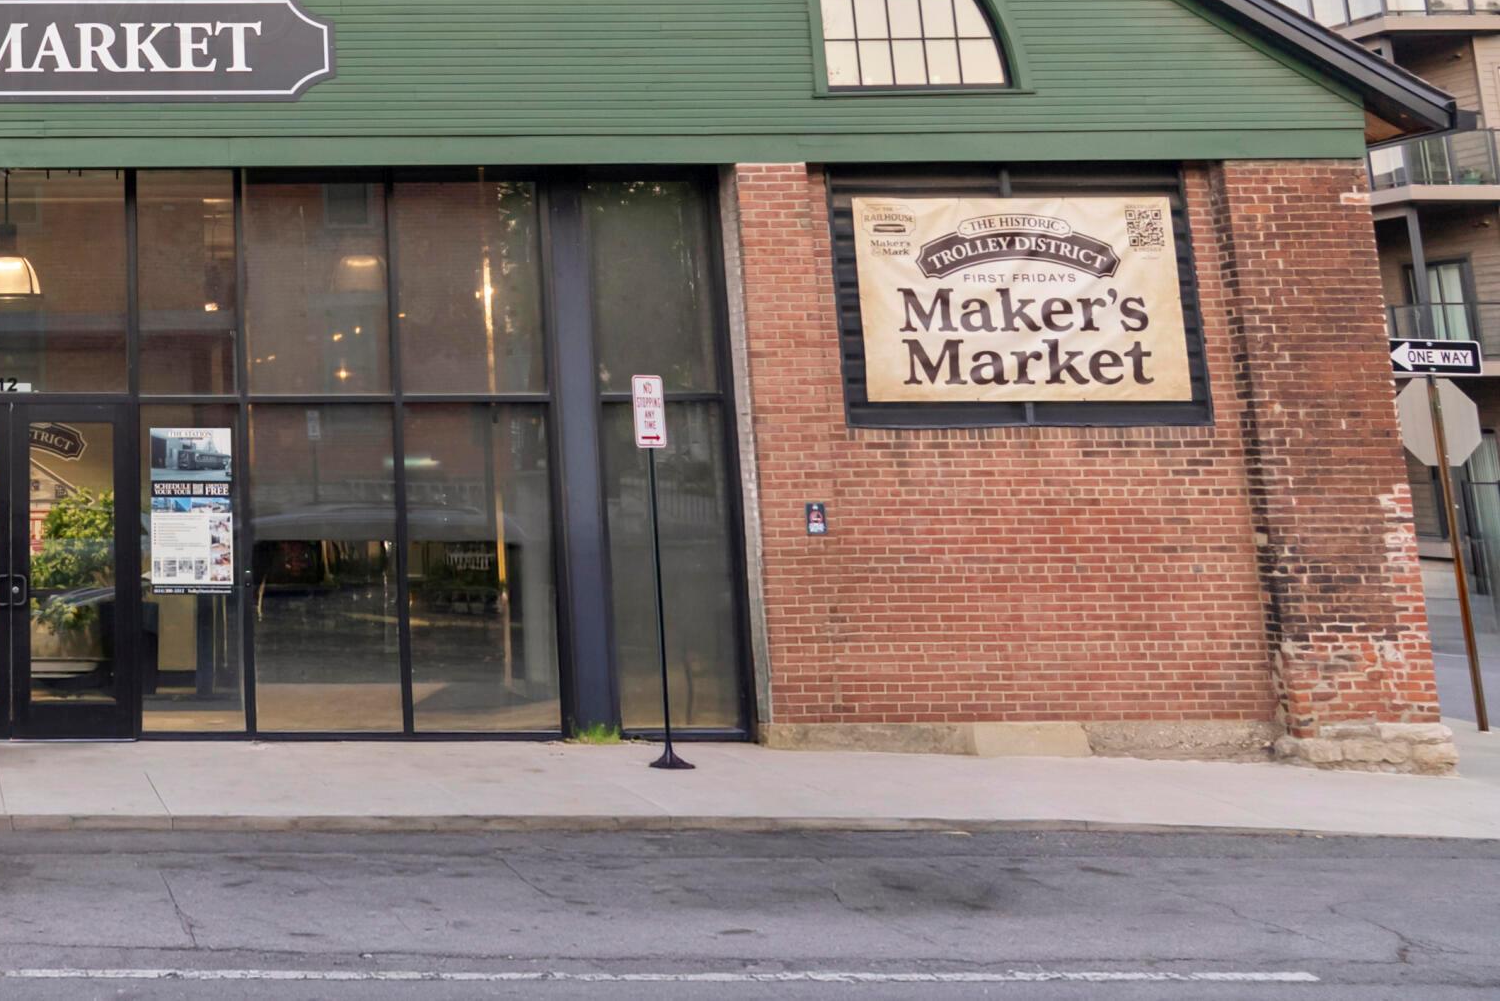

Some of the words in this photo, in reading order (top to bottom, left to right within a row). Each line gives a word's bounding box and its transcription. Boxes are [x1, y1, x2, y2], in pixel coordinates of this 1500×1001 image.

[864, 213, 913, 223] RAILHOUSE
[969, 217, 996, 232] THE
[999, 217, 1061, 232] HISTORIC
[882, 248, 910, 256] Mark
[927, 237, 1011, 270] TROLLEY
[1014, 236, 1108, 270] DISTRICT
[963, 273, 1006, 283] FIRST
[1012, 273, 1077, 283] FRIDAYS
[897, 287, 1150, 333] Maker's
[901, 338, 1155, 386] Market
[1407, 350, 1435, 364] ONE
[1440, 351, 1469, 364] WAY
[643, 382, 653, 394] NO
[636, 397, 661, 408] STOPPING
[644, 410, 655, 418] ANY
[644, 420, 657, 429] TIME
[205, 486, 229, 496] FREE
